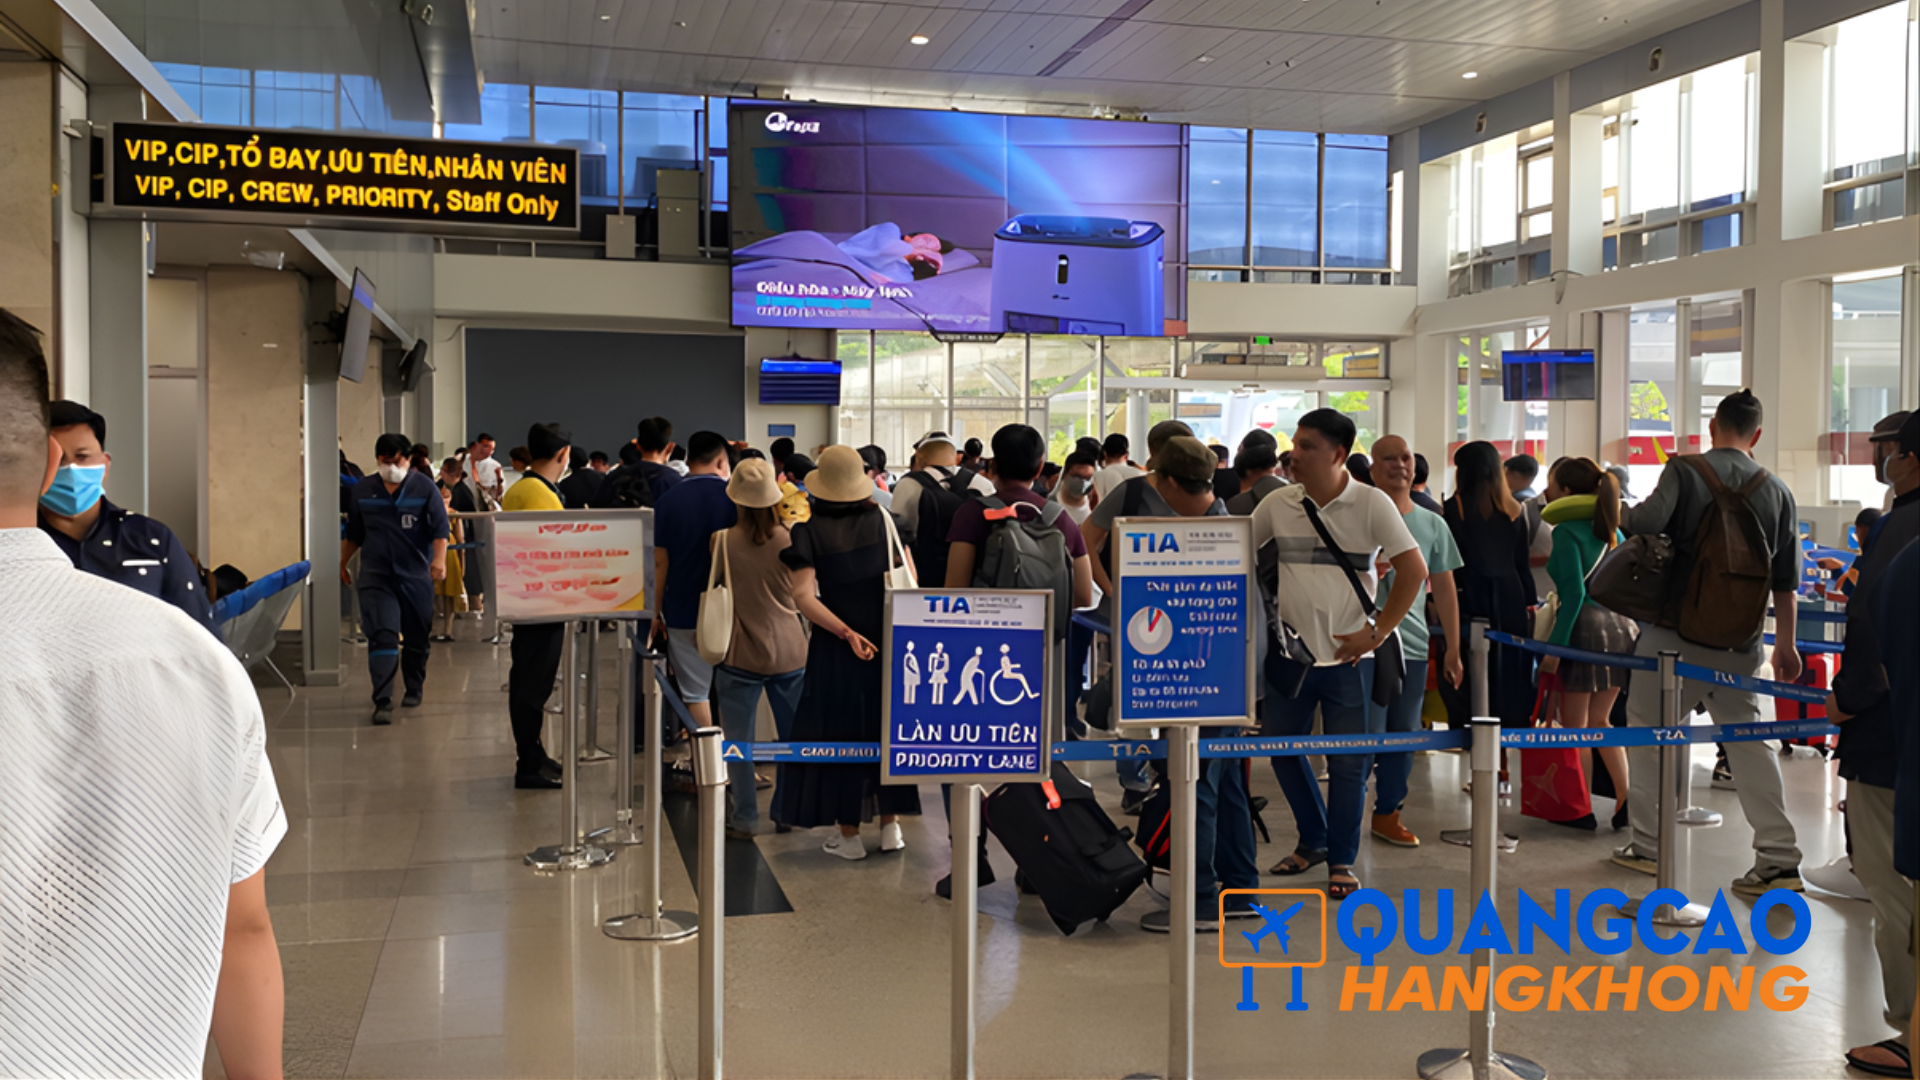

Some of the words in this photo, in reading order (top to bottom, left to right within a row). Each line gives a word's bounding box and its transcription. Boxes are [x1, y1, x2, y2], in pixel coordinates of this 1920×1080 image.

[124, 134, 262, 169] VIP,CIP,TỔ
[369, 148, 503, 181] TIÊN,NHÂN
[510, 157, 567, 184] VIÊN
[135, 174, 181, 201] VIP,
[187, 177, 235, 204] CIP,
[241, 180, 320, 208] CREW,
[326, 184, 440, 214] PRIORITY,
[446, 188, 501, 213] Staff
[507, 192, 559, 221] Only
[1125, 532, 1180, 553] TIA
[923, 595, 970, 614] TIA
[898, 718, 942, 741] LÀN
[1108, 743, 1152, 757] TIA
